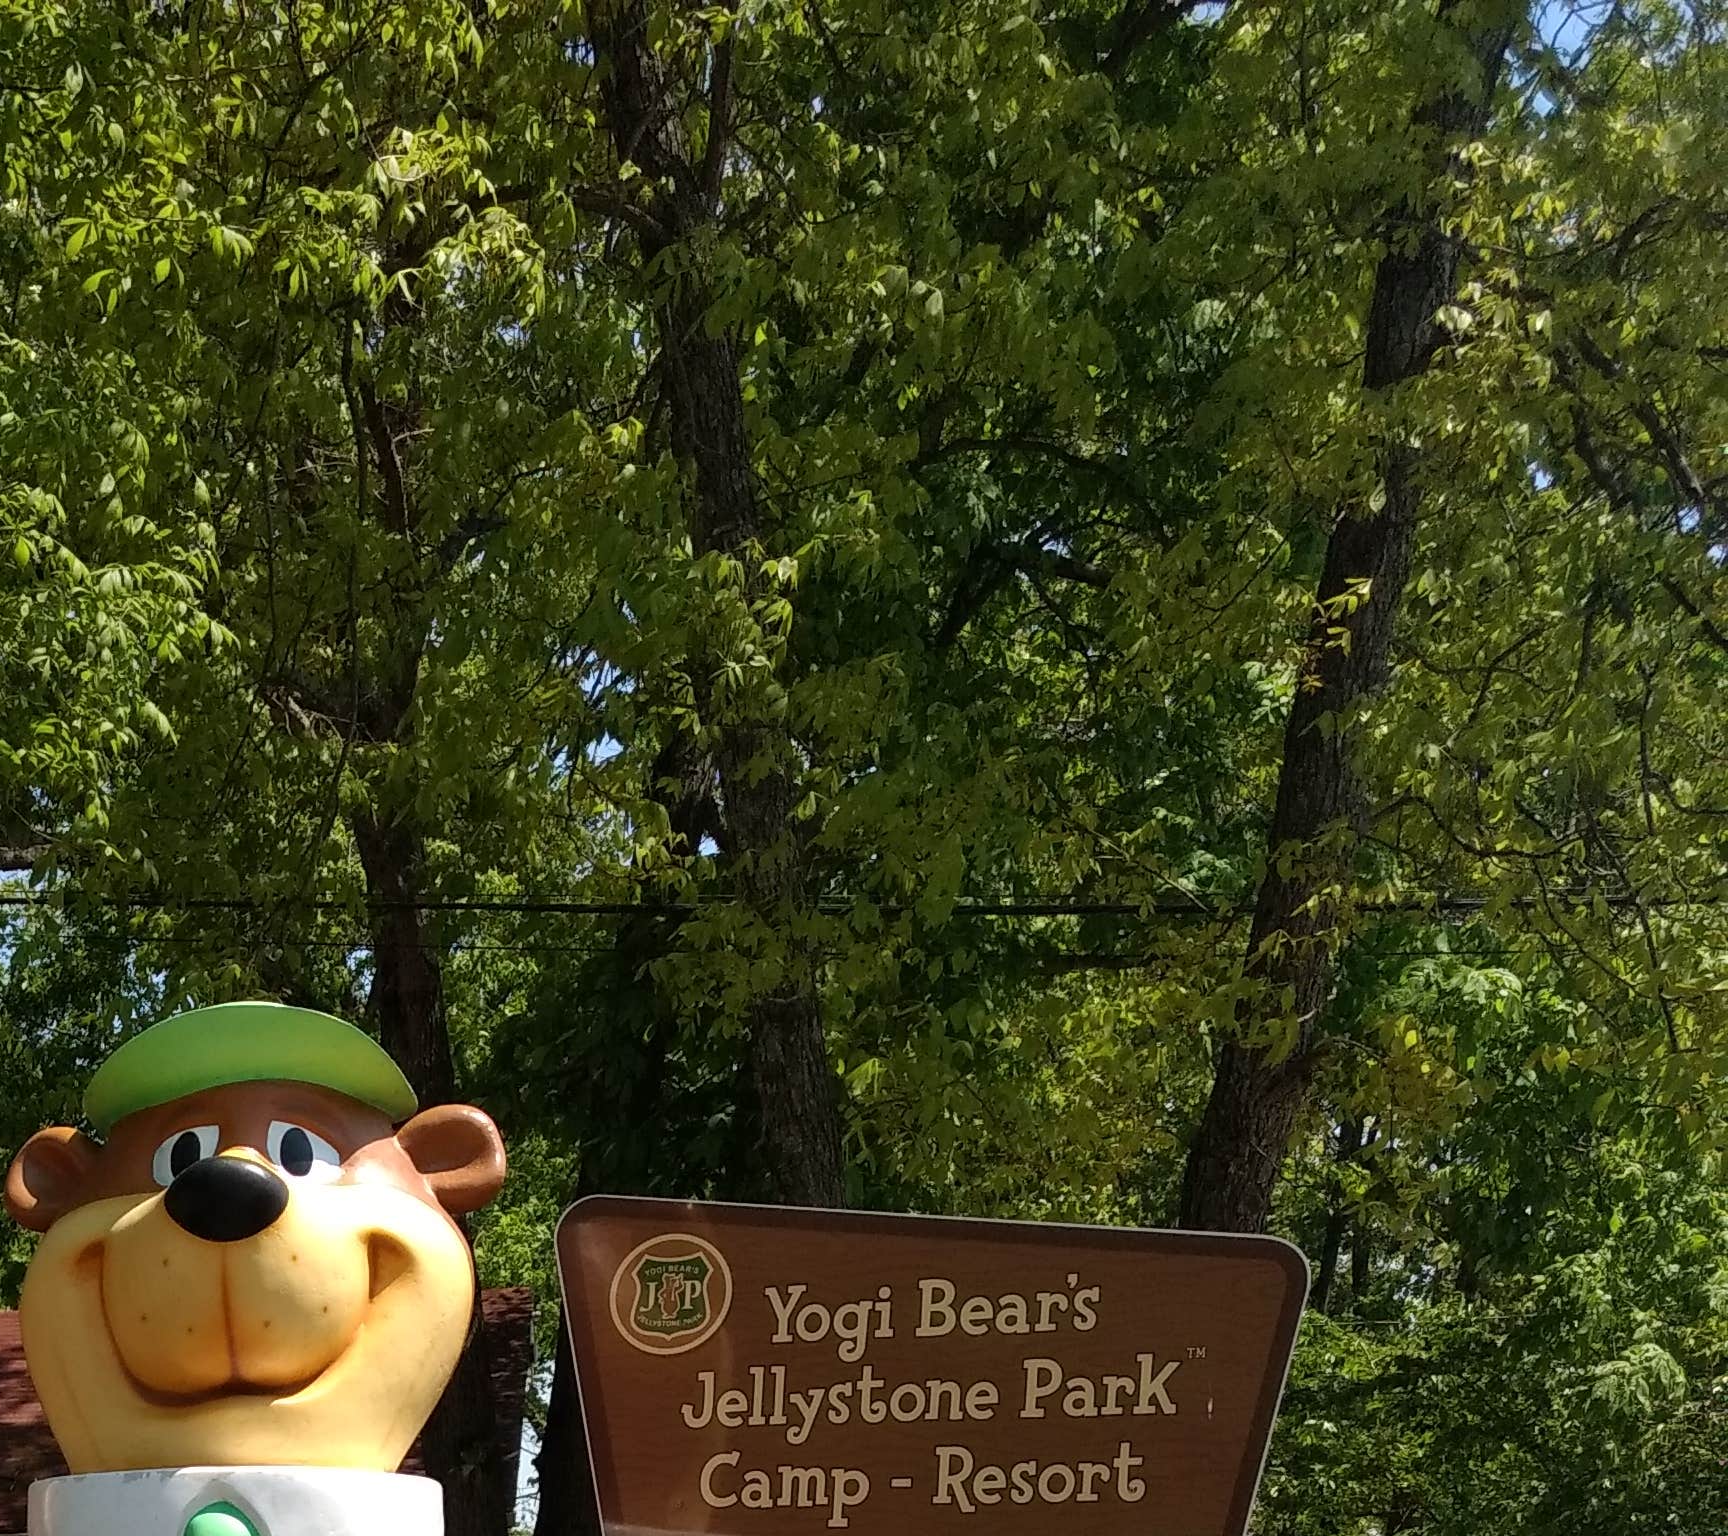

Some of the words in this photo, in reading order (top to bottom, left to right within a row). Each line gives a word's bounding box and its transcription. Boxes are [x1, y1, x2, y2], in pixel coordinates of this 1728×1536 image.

[644, 1266, 666, 1277] YOGI
[668, 1264, 700, 1275] BEAR'S
[764, 1284, 895, 1363] Yogi
[915, 1273, 1102, 1338] Bear's
[680, 1364, 1000, 1446] Jellystone
[1018, 1352, 1182, 1420] Park
[699, 1450, 871, 1529] Camp
[931, 1441, 1147, 1514] Resort
